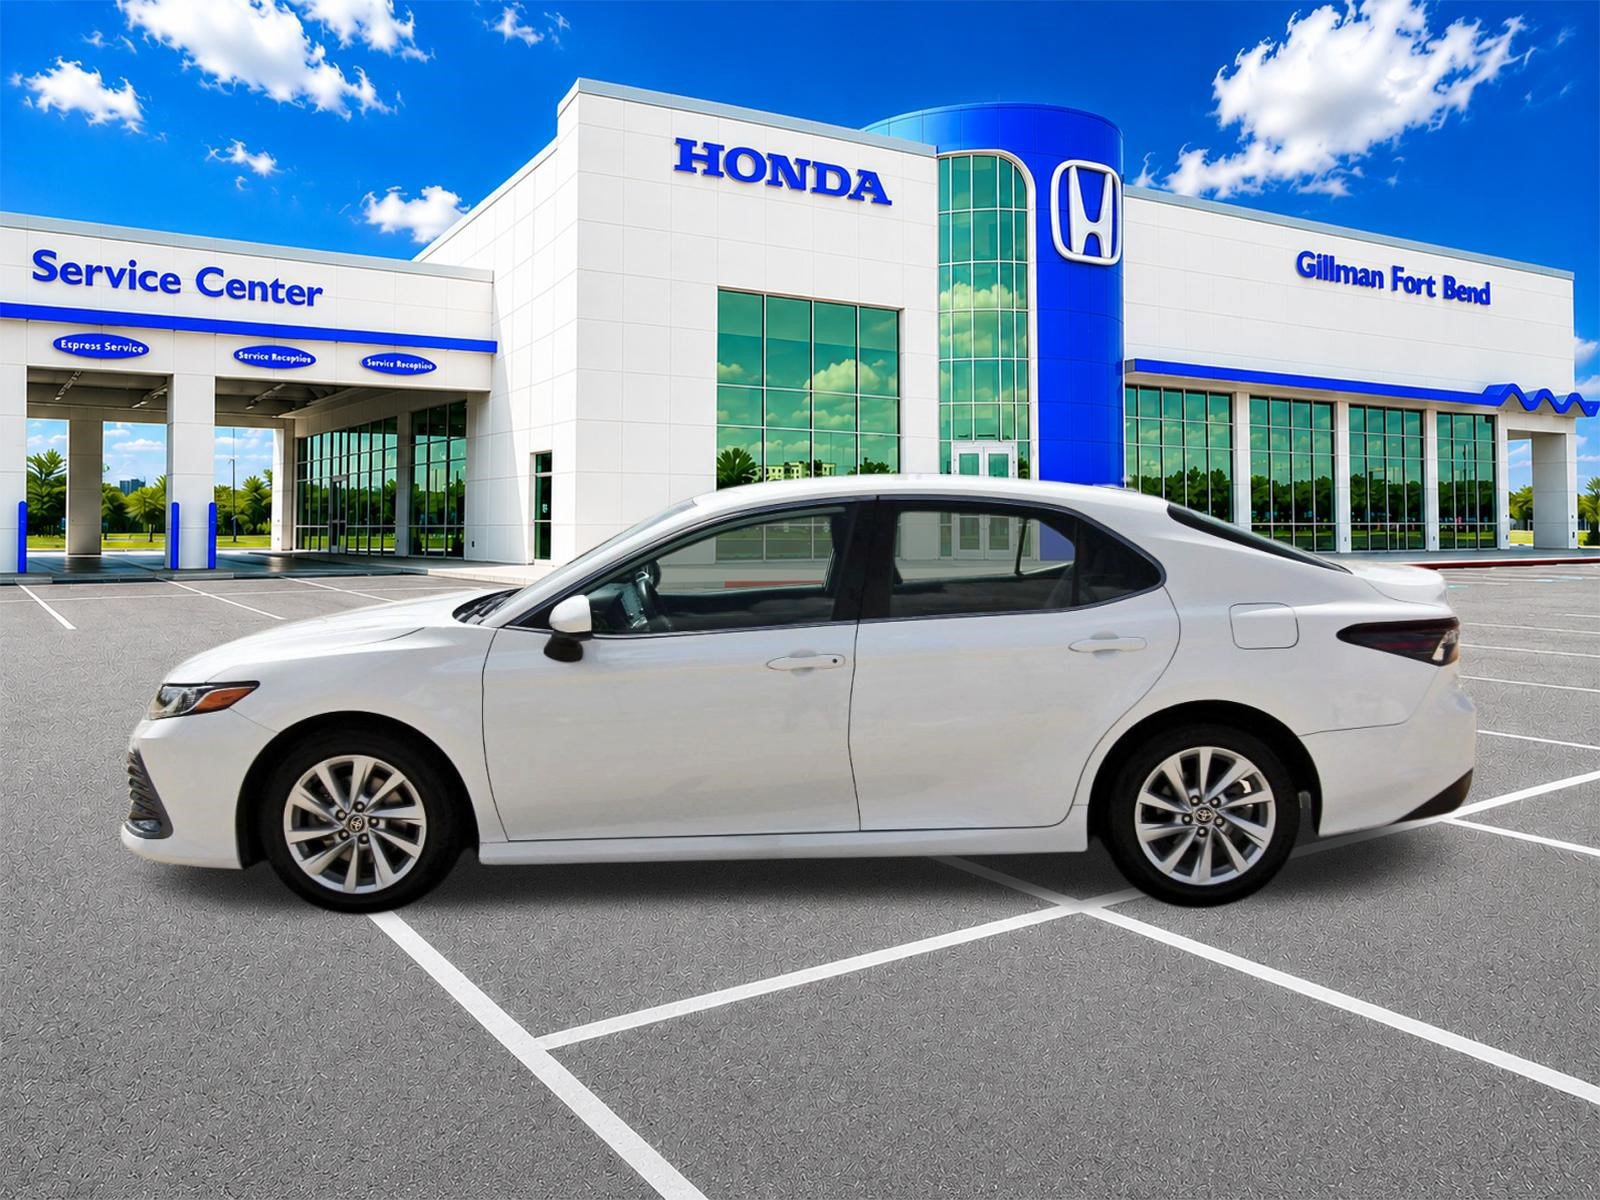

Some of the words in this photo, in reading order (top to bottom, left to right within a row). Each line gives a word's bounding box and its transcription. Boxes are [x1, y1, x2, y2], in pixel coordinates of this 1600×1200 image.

[674, 137, 892, 206] HONDA
[32, 249, 182, 295] Service
[196, 267, 324, 308] Center
[1296, 250, 1385, 289] Gillman
[1391, 265, 1437, 298] Fort
[1442, 274, 1491, 305] Bend
[104, 342, 144, 353] Service
[238, 351, 269, 361] Service
[366, 358, 394, 368] Service
